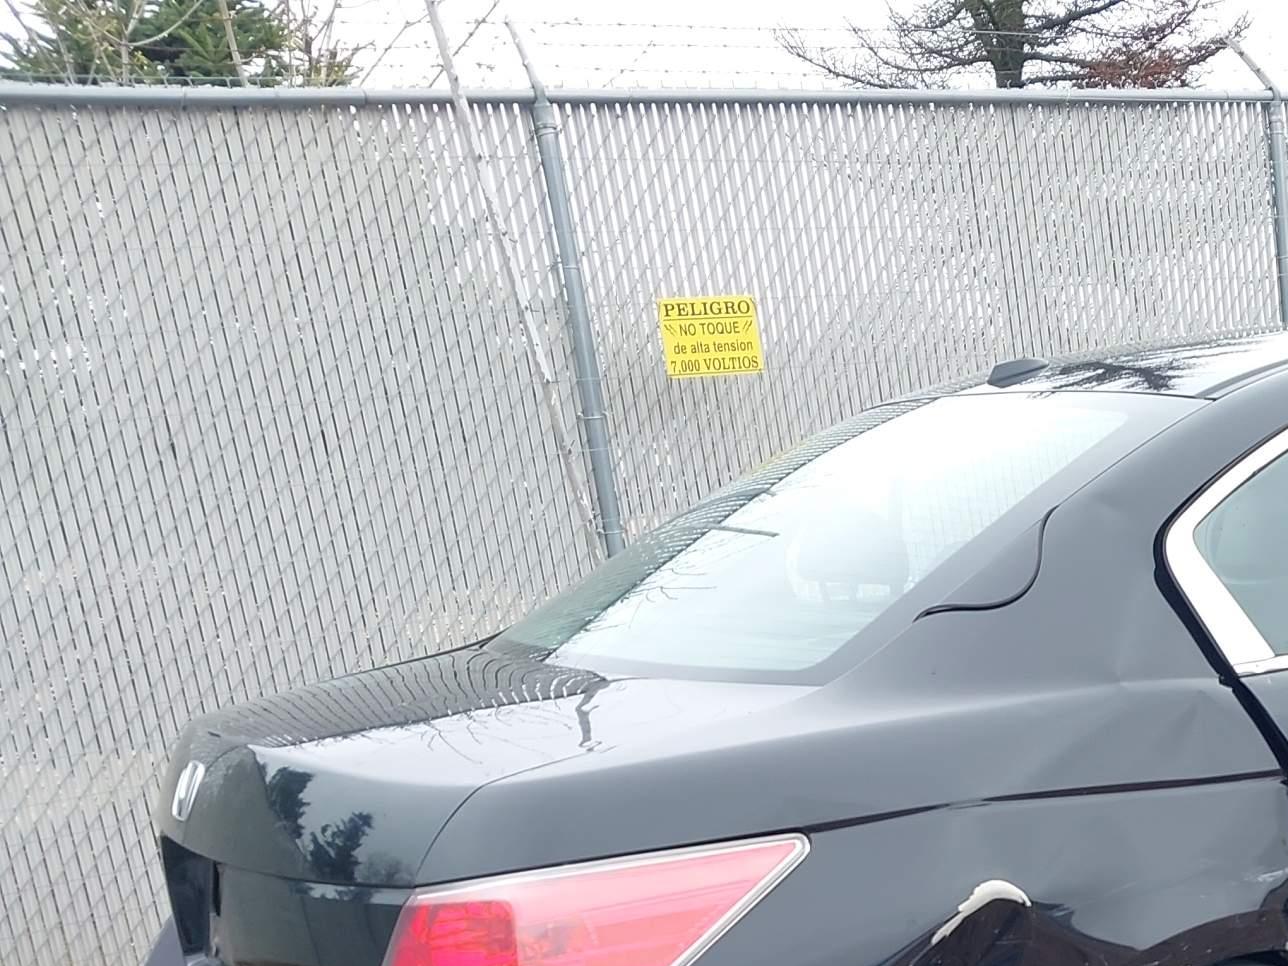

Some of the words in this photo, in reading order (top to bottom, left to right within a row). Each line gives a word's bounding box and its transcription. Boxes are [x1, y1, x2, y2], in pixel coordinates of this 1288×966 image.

[663, 300, 750, 317] PELIGRO
[679, 323, 697, 336] NO
[699, 321, 741, 335] TOQUE
[673, 342, 688, 355] de
[690, 341, 710, 354] alta
[712, 339, 753, 353] tension
[671, 359, 700, 373] 7,000
[703, 356, 759, 370] VOLTIOS
